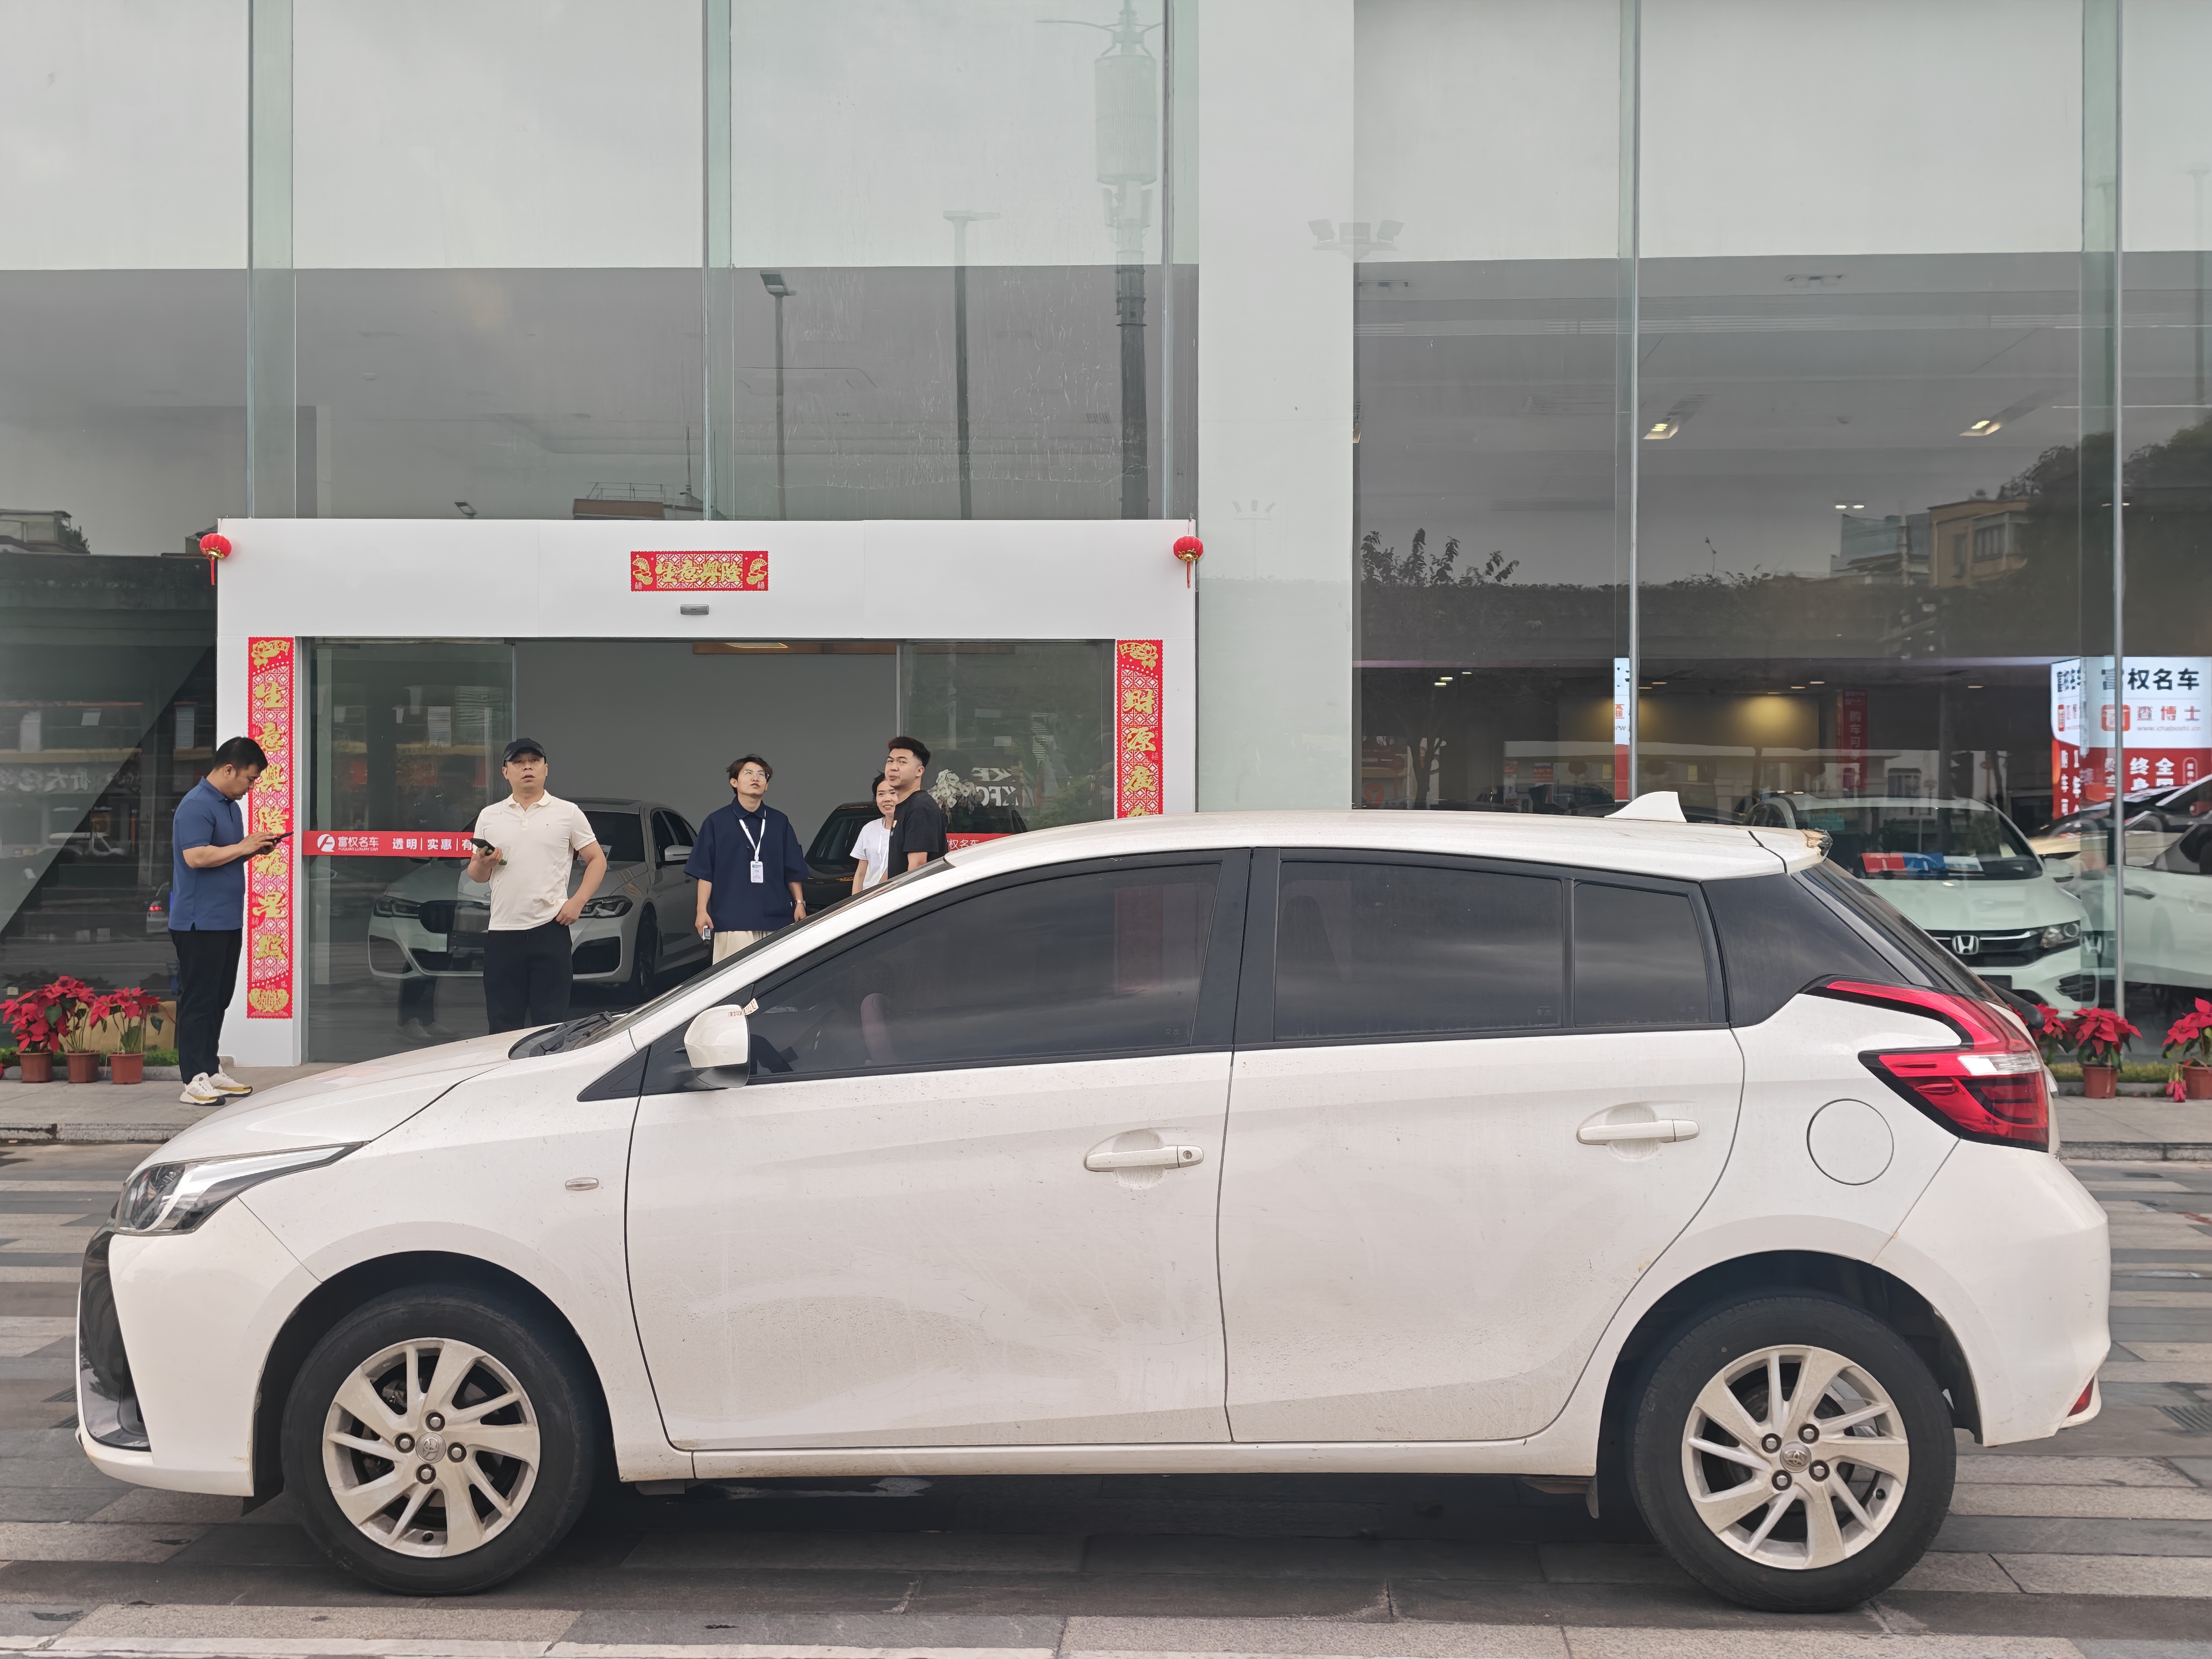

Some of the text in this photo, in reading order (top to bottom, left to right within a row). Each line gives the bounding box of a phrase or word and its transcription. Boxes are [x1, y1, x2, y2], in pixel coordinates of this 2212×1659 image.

[338, 836, 379, 847] 富权名车
[392, 838, 417, 849] 透明
[427, 838, 452, 850] 实惠
